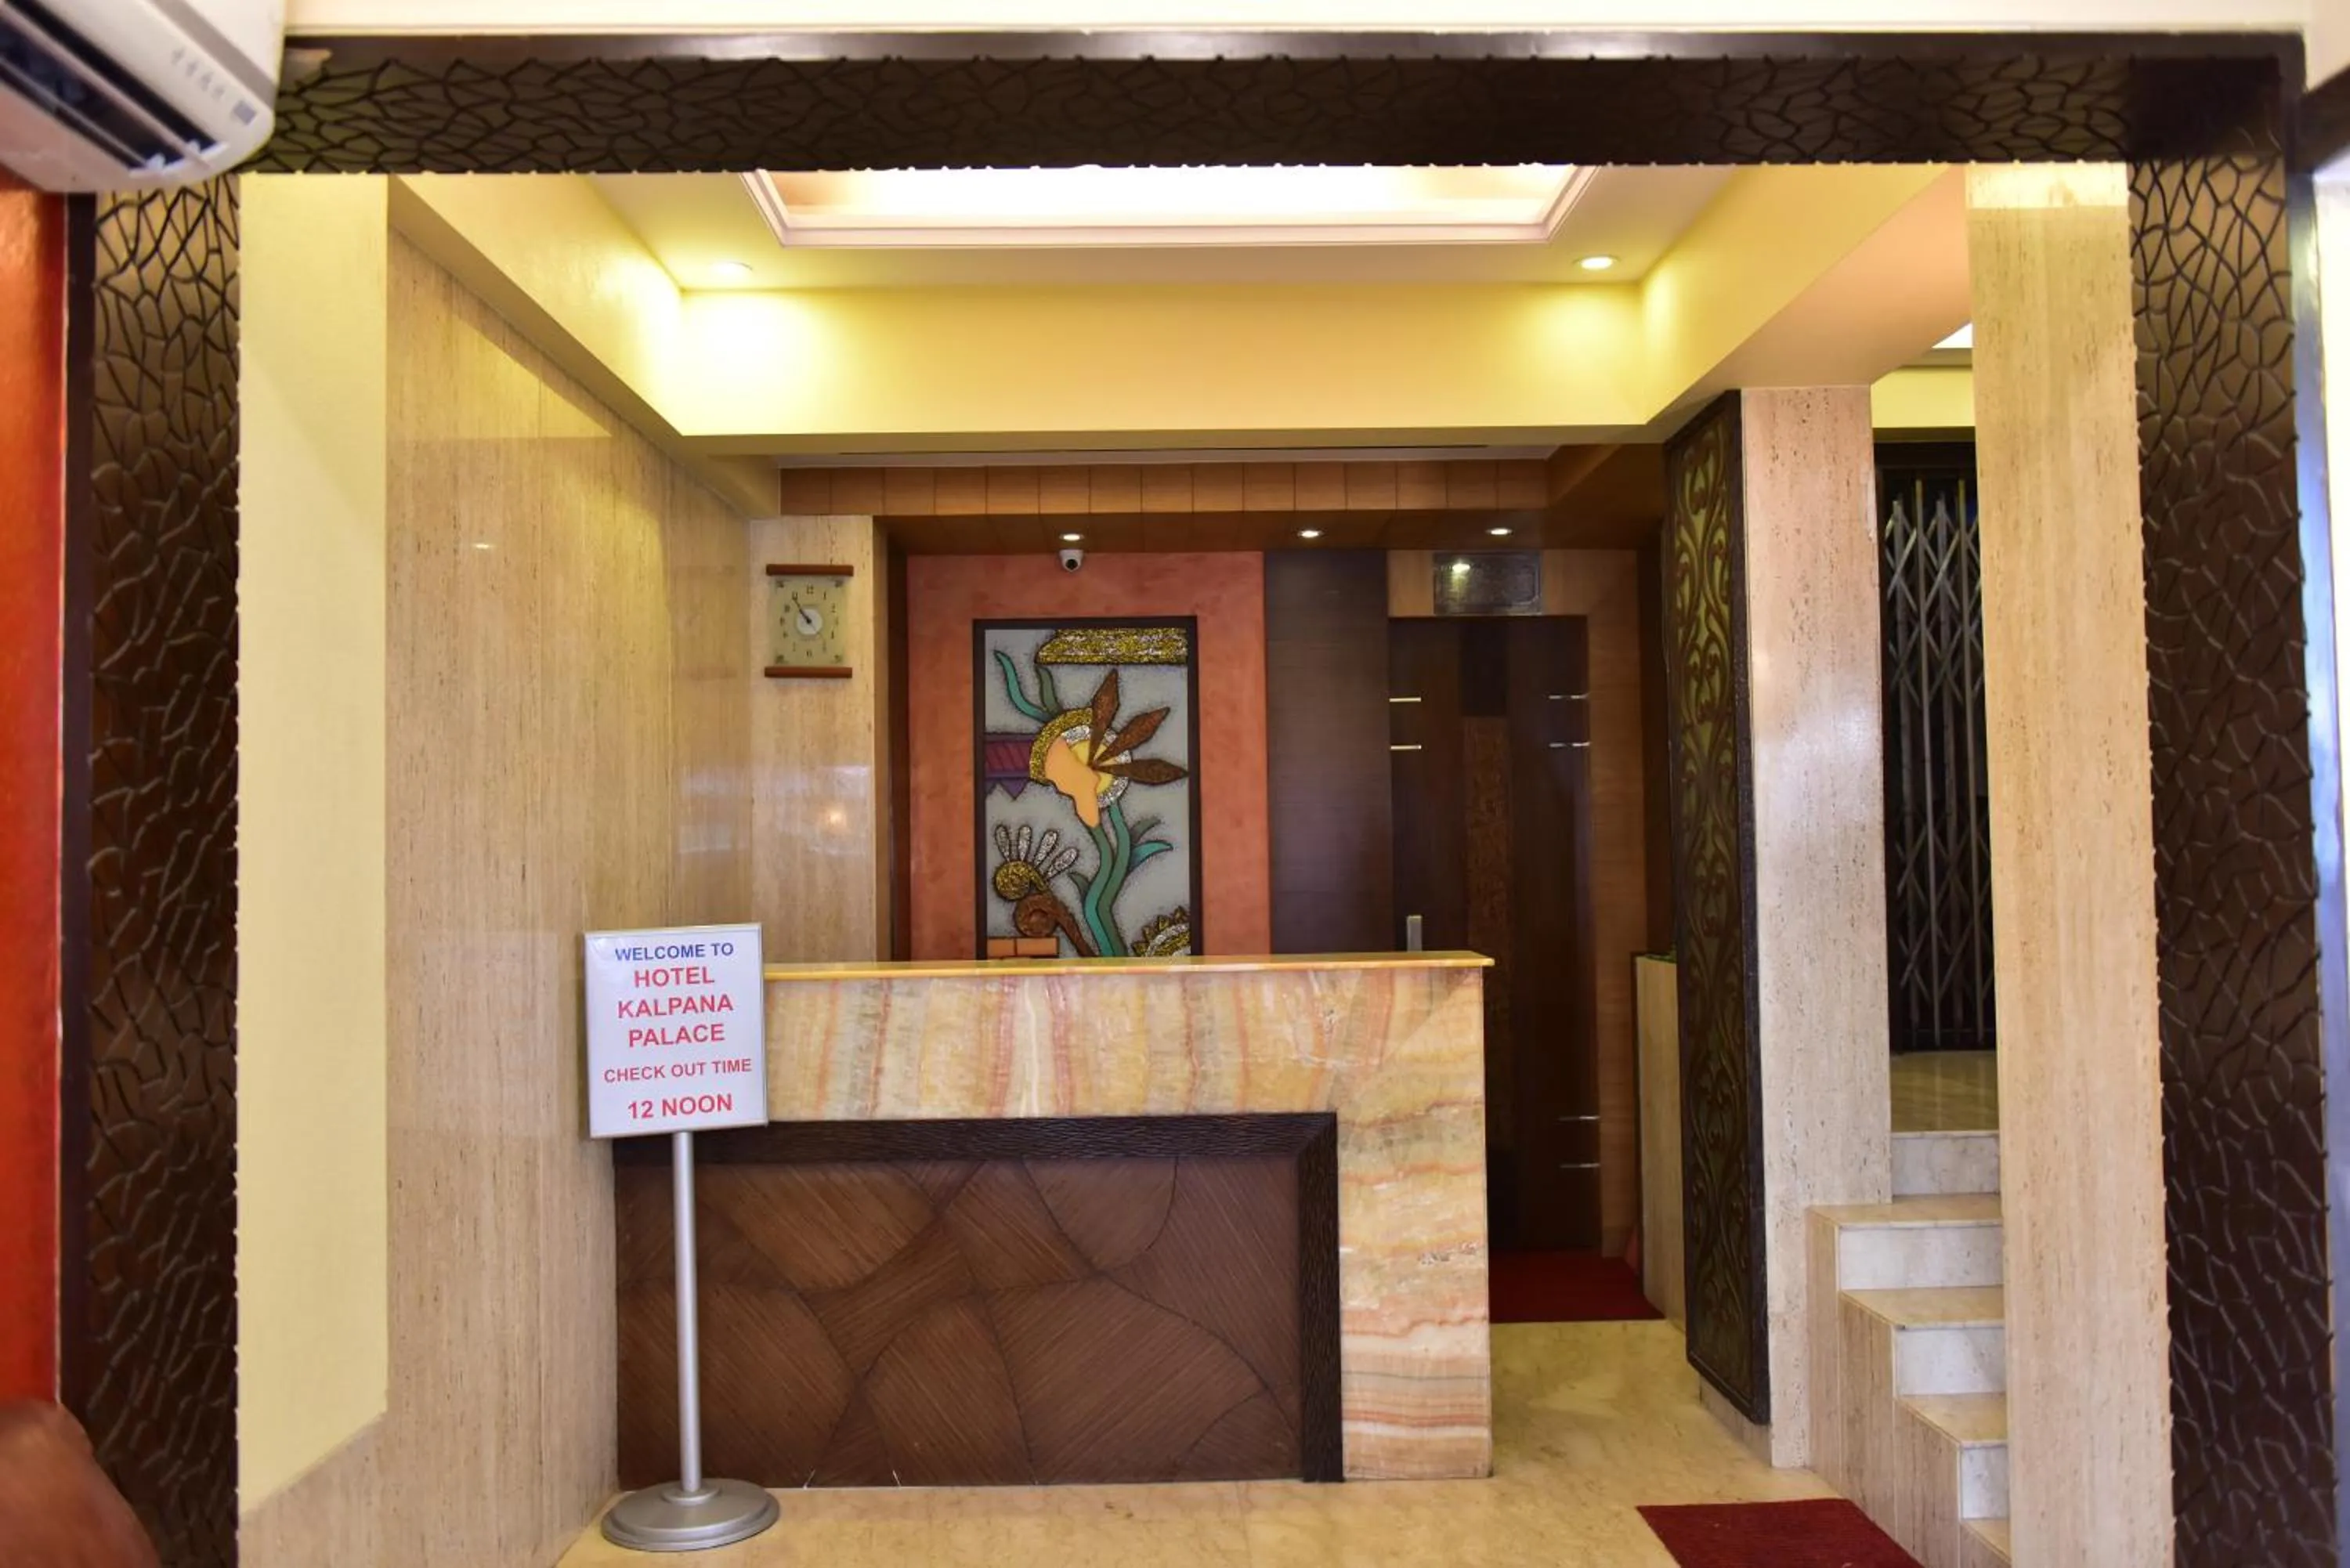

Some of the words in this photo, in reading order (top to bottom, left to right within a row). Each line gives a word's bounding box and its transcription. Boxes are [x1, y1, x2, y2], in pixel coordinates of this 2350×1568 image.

[615, 944, 706, 961] WELCOME
[710, 942, 734, 956] TO
[634, 966, 715, 988] HOTEL
[617, 994, 734, 1019] KALPANA
[628, 1023, 725, 1047] PALACE
[603, 1065, 666, 1083] CHECK
[671, 1061, 707, 1078] OUT
[711, 1058, 753, 1074] TIME
[627, 1100, 654, 1119] 12
[661, 1093, 732, 1117] NOON
